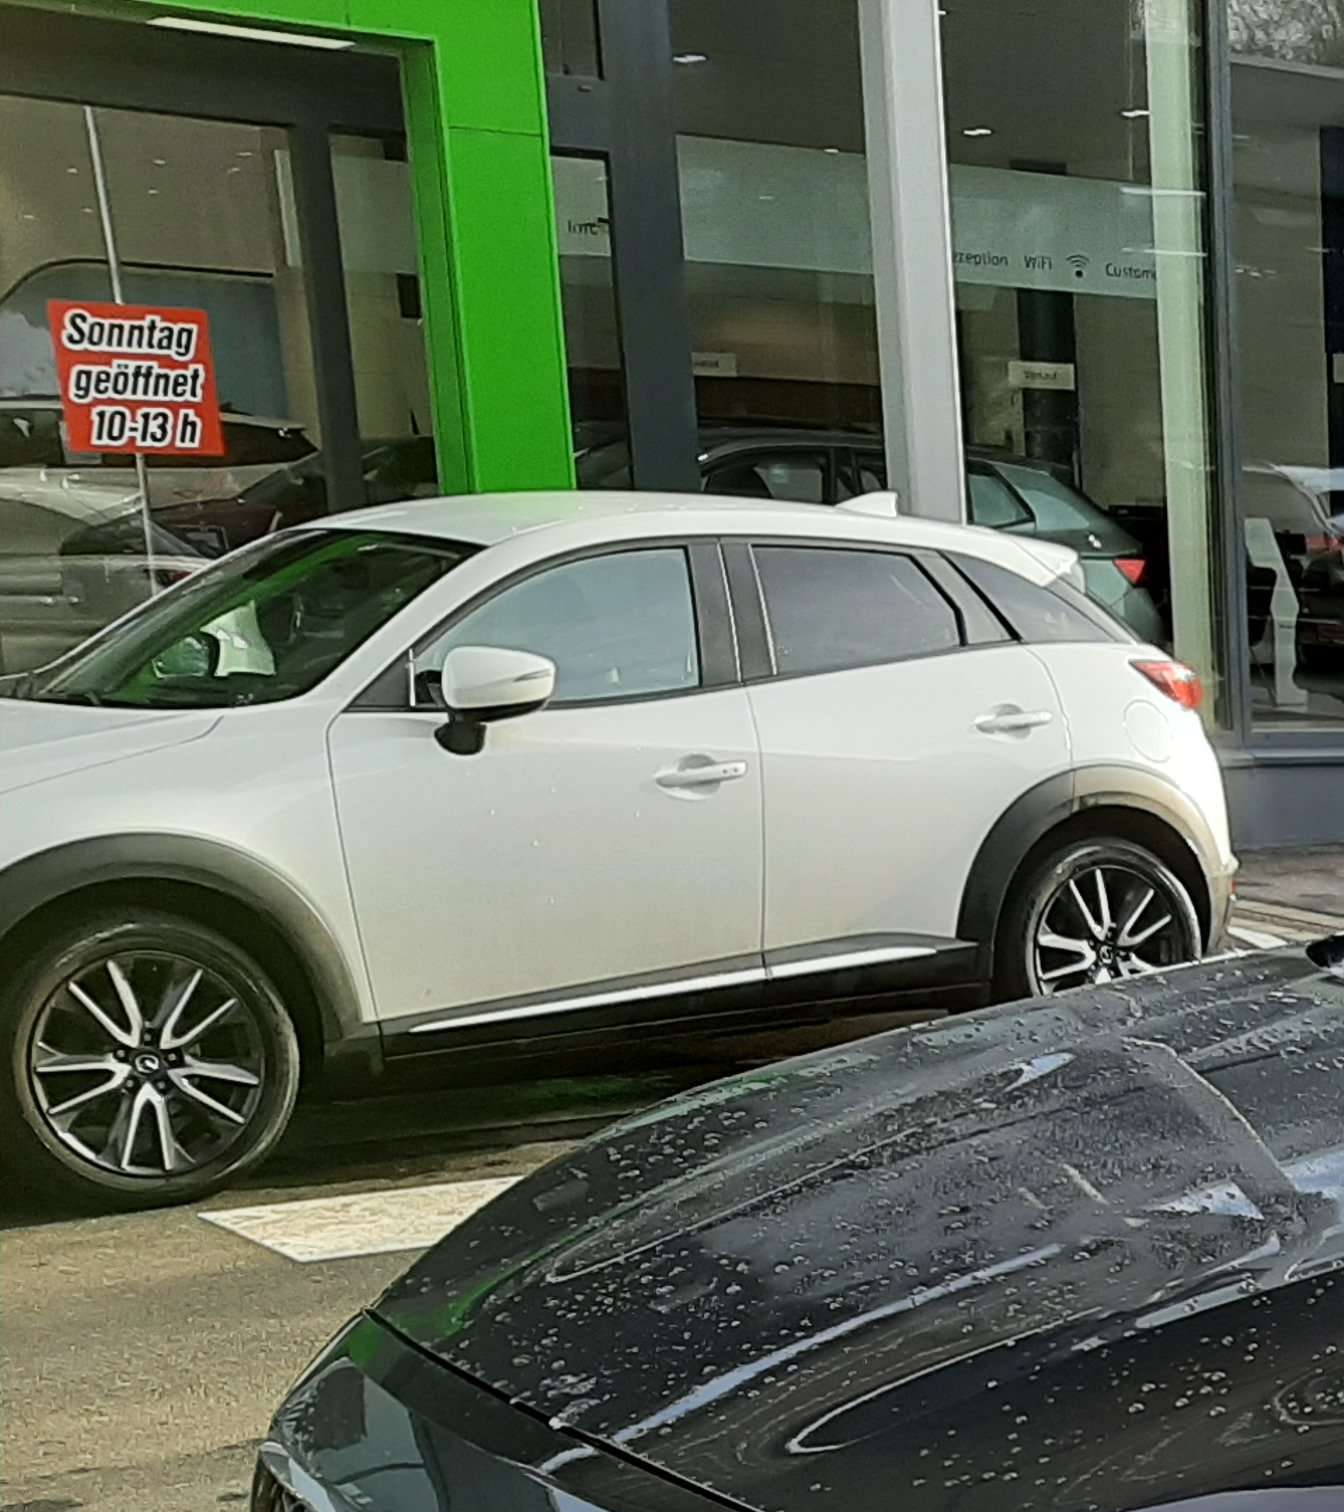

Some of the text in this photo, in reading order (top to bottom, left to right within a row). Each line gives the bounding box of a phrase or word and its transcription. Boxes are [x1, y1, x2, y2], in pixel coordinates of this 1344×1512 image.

[64, 311, 195, 358] Sonntag
[72, 362, 201, 401] geöffnet
[94, 408, 199, 445] 10-13 h
